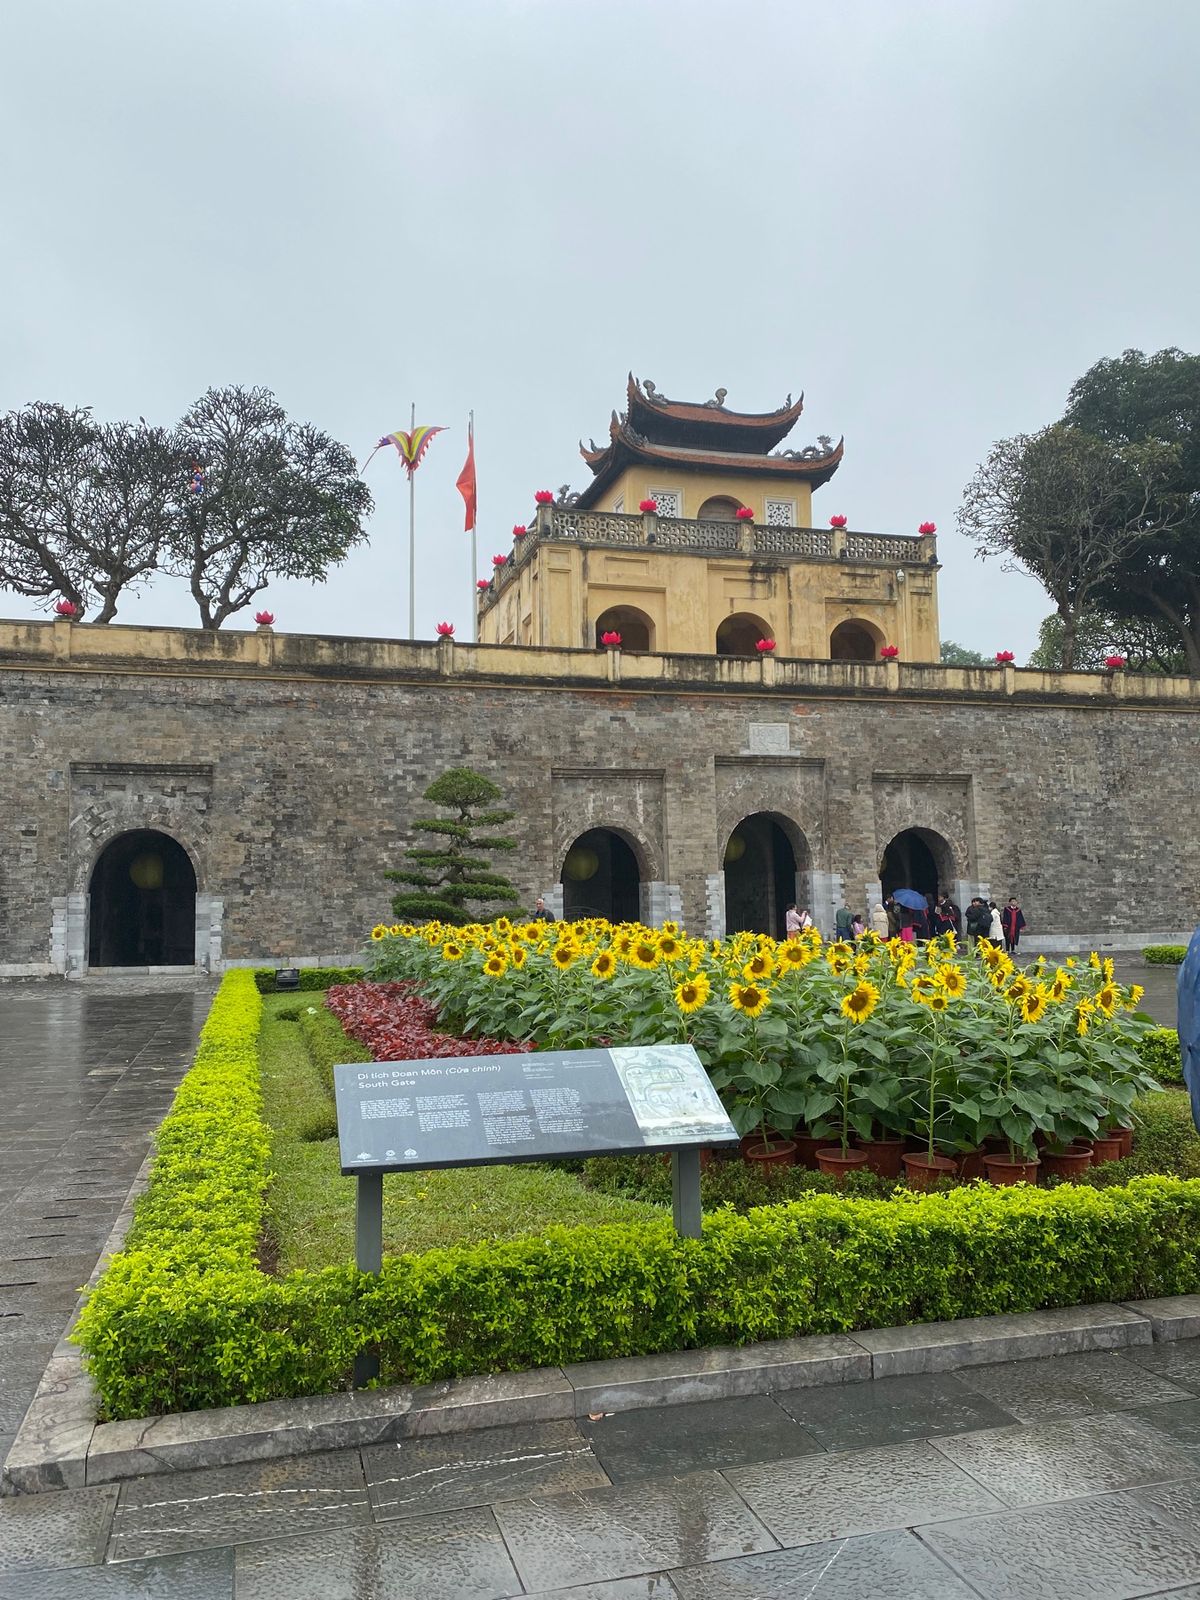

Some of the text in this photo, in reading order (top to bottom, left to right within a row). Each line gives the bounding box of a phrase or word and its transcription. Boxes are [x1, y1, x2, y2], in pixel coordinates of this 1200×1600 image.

[392, 1070, 418, 1078] Đoan
[421, 1068, 442, 1076] Môn
[472, 1064, 501, 1073] chính)
[358, 1079, 416, 1089] South Gate
